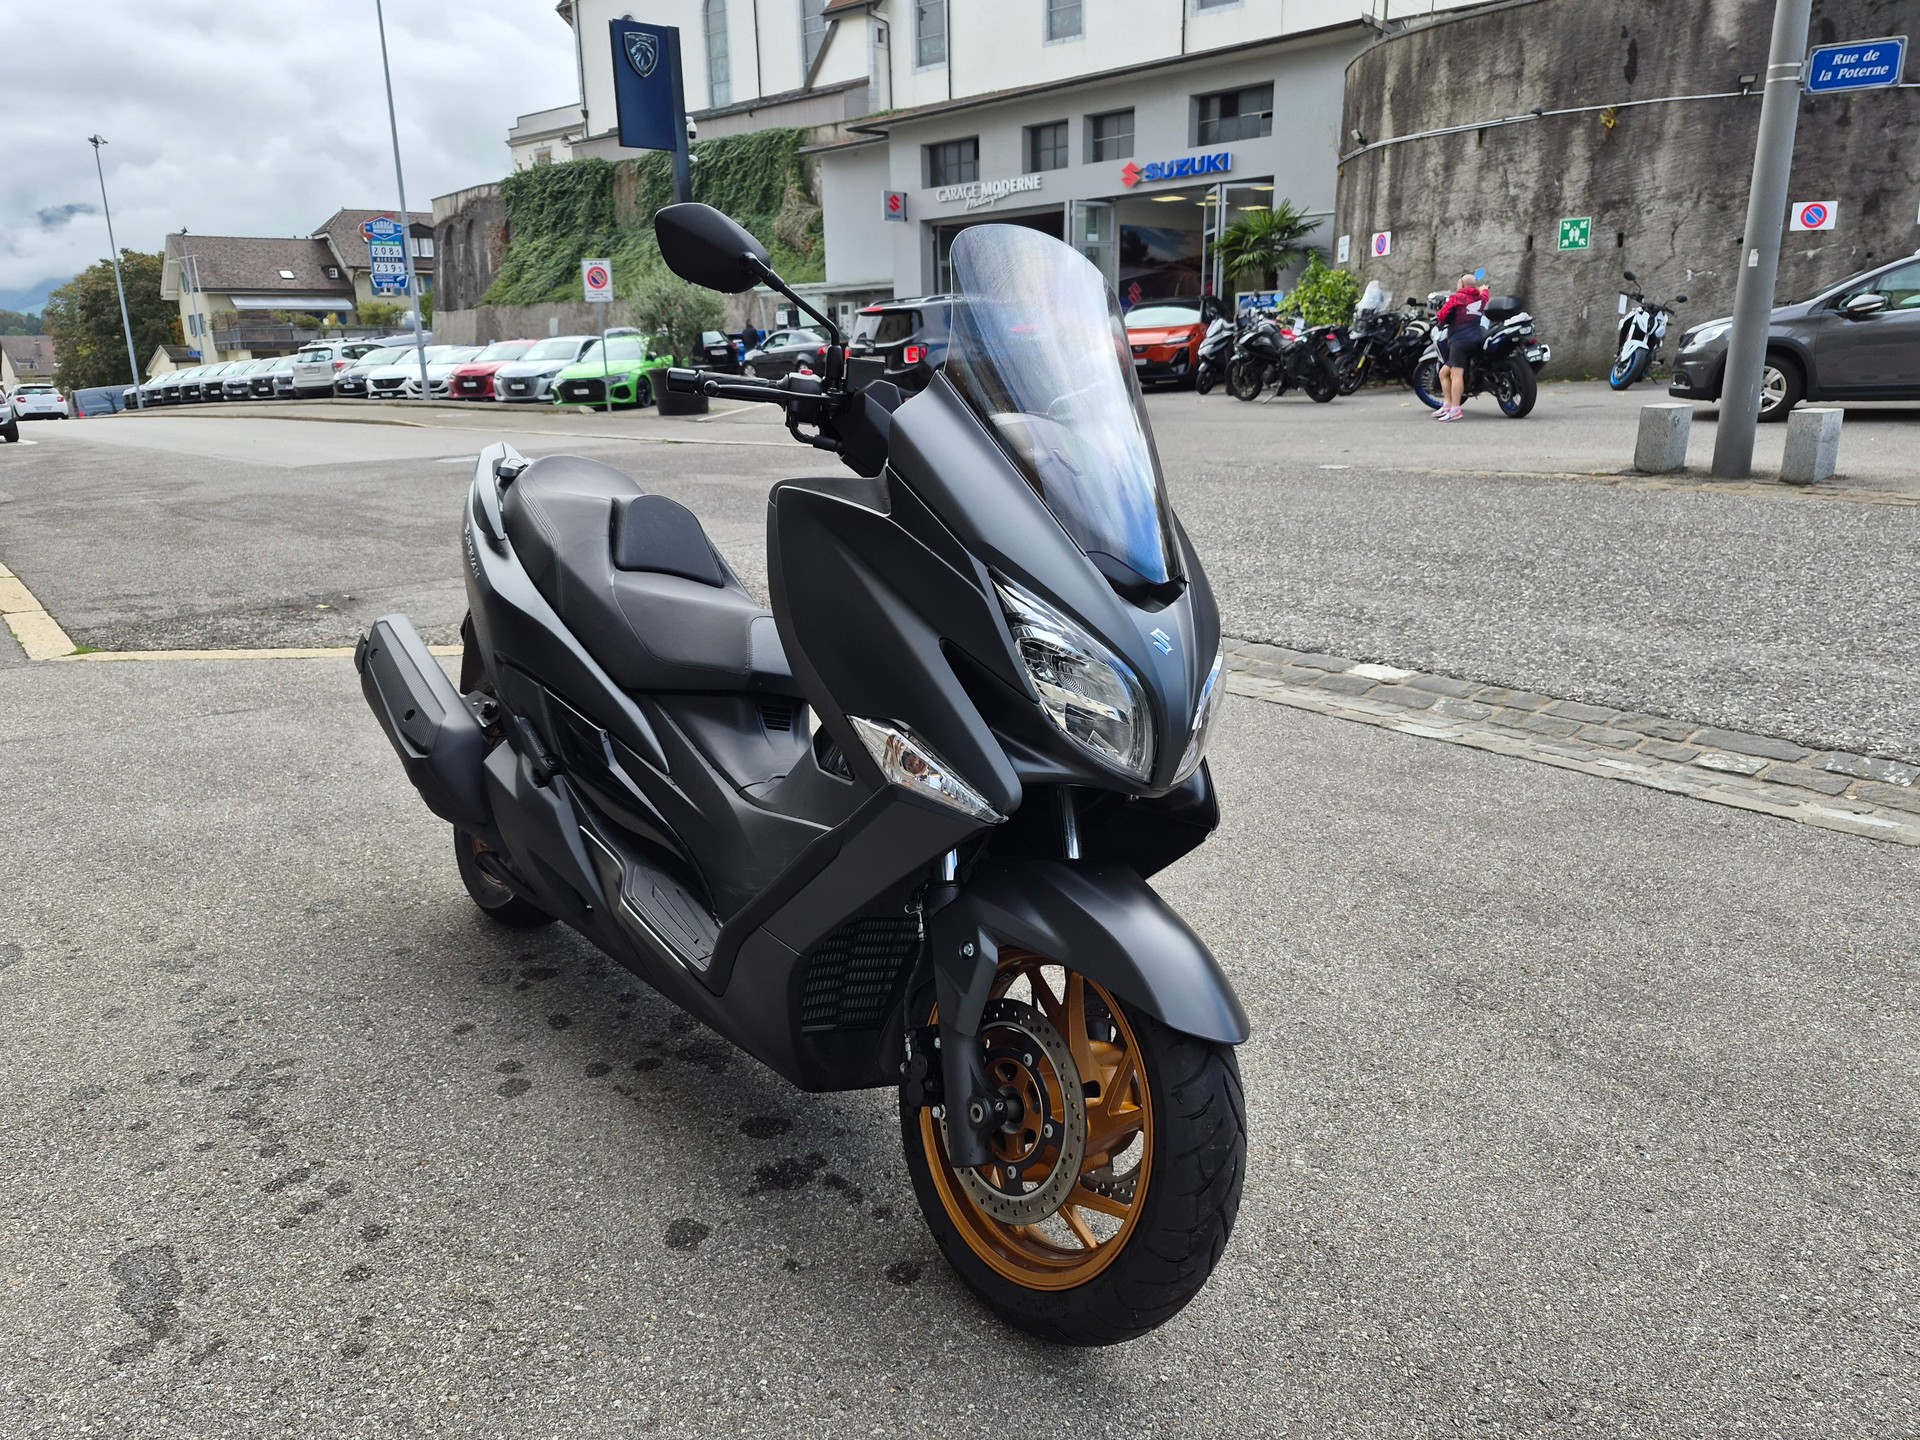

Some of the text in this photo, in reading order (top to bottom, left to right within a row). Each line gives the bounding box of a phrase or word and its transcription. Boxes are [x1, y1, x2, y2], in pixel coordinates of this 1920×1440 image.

[1832, 49, 1880, 65] Rue de
[1818, 65, 1889, 81] la Poterne
[1144, 152, 1231, 181] SUZUKI
[936, 175, 1041, 203] GARAGE MODERNE
